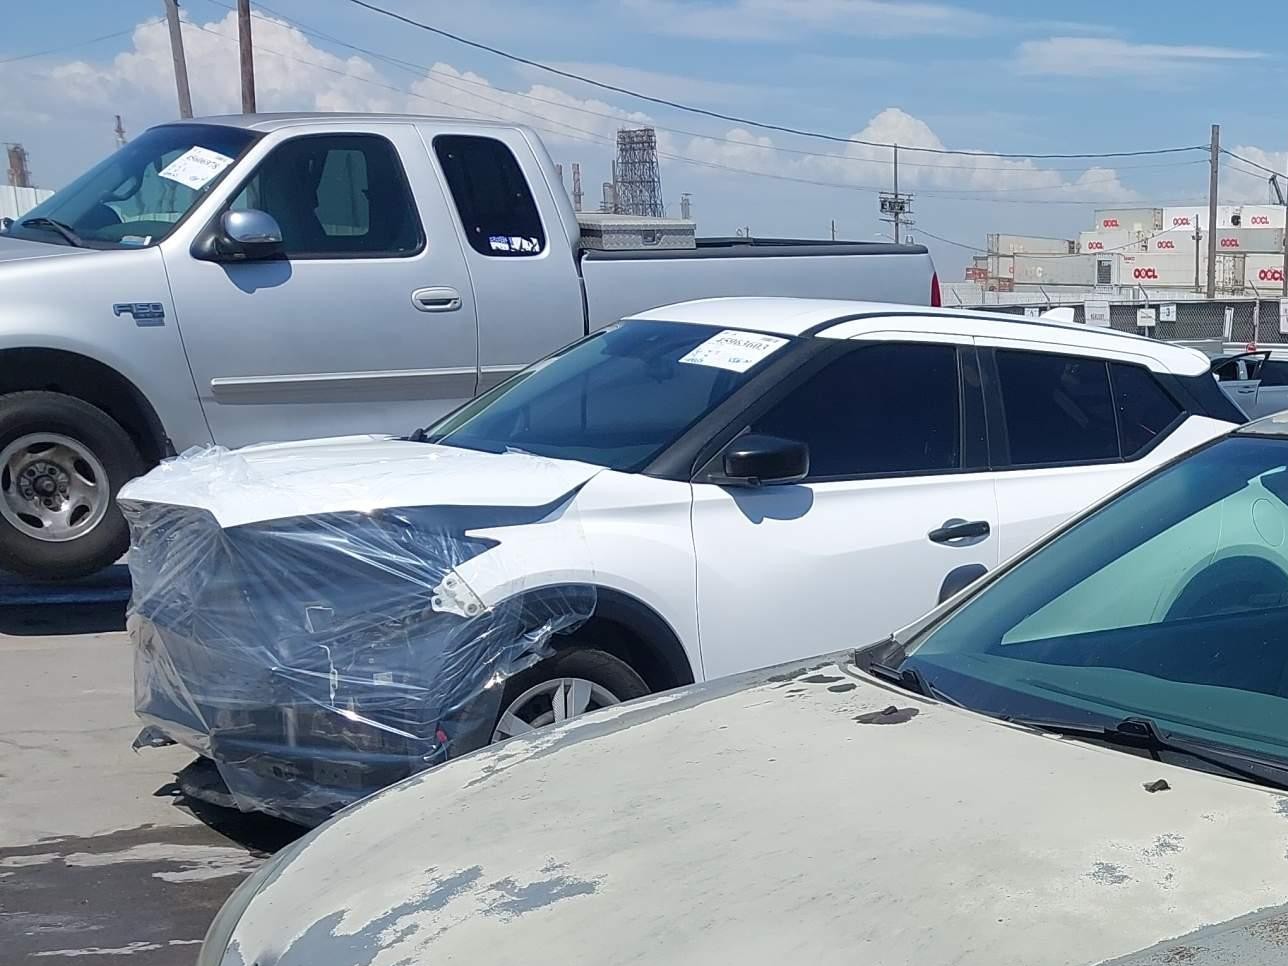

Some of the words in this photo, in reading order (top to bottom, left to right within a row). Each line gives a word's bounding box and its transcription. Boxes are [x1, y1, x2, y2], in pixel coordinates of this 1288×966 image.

[1103, 219, 1120, 228] OOCL
[1173, 217, 1191, 226] OOCL
[1250, 215, 1270, 225] OOCL
[1088, 241, 1104, 250] OOCL
[1157, 240, 1175, 249] OOCL
[1220, 238, 1240, 248] OOCL
[1133, 268, 1158, 279] OOCL
[1258, 269, 1285, 281] OOCL
